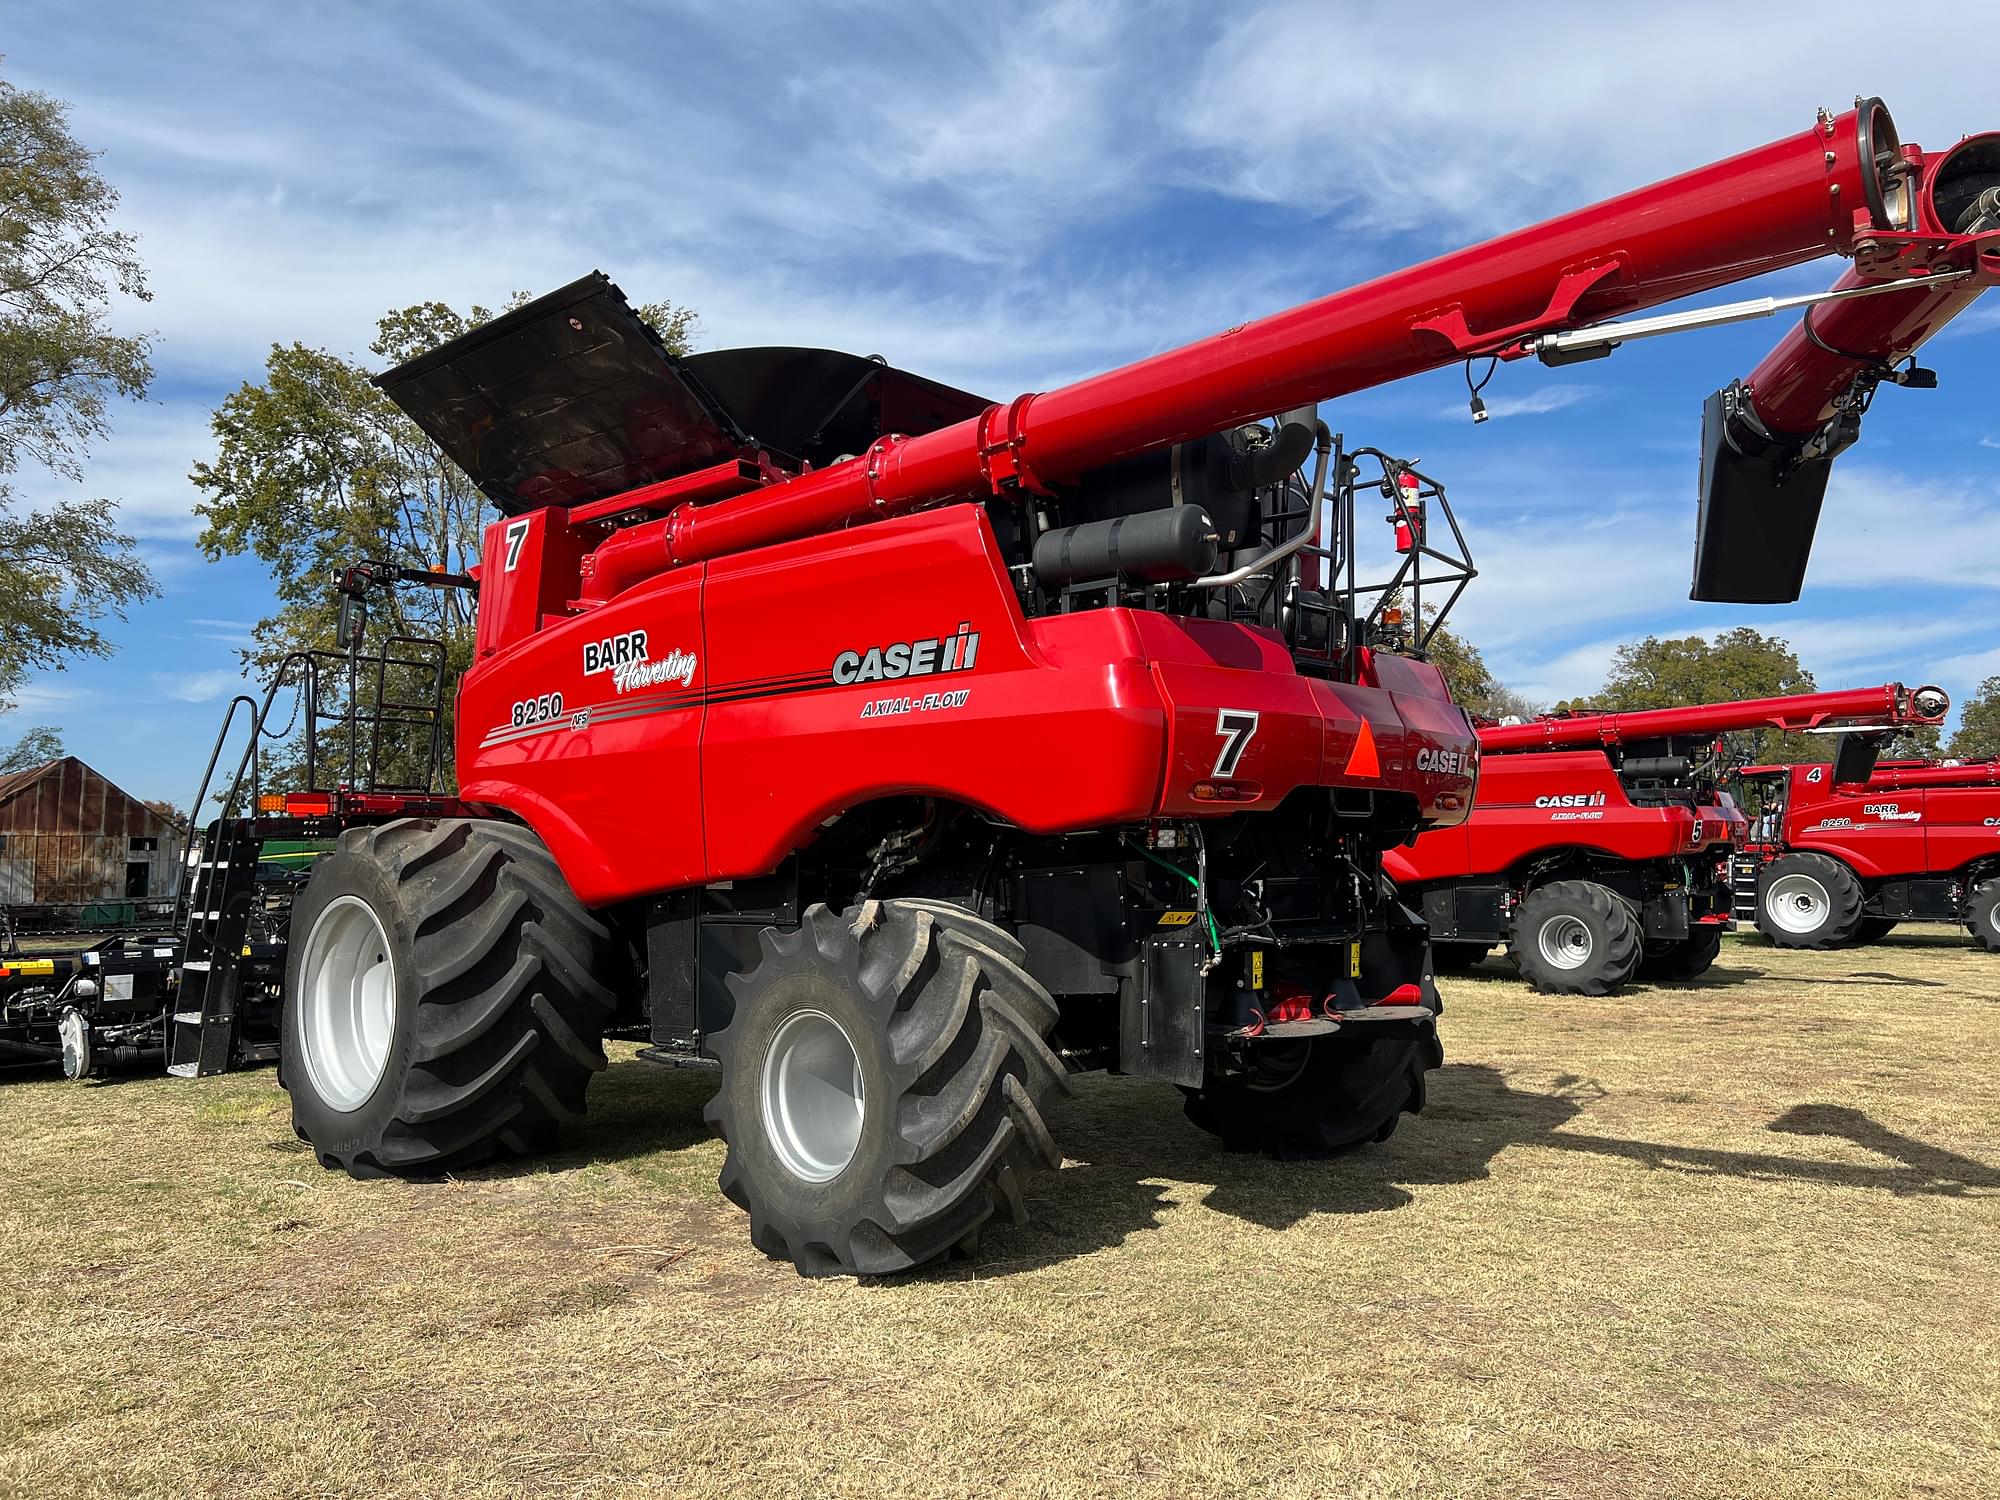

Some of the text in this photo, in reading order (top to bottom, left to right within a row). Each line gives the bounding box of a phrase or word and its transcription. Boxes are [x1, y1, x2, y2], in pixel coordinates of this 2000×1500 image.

[504, 518, 530, 573] 7
[584, 630, 648, 676] BARR
[832, 638, 939, 685] CASE
[613, 648, 697, 694] Harvesting
[512, 692, 563, 727] 8250
[1210, 707, 1260, 779] 7
[1416, 747, 1458, 774] CASE
[1806, 767, 1821, 783] 4
[1535, 794, 1587, 808] CASE
[1864, 804, 1899, 814] BARR
[1692, 819, 1703, 843] 5
[1820, 818, 1851, 828] 8250
